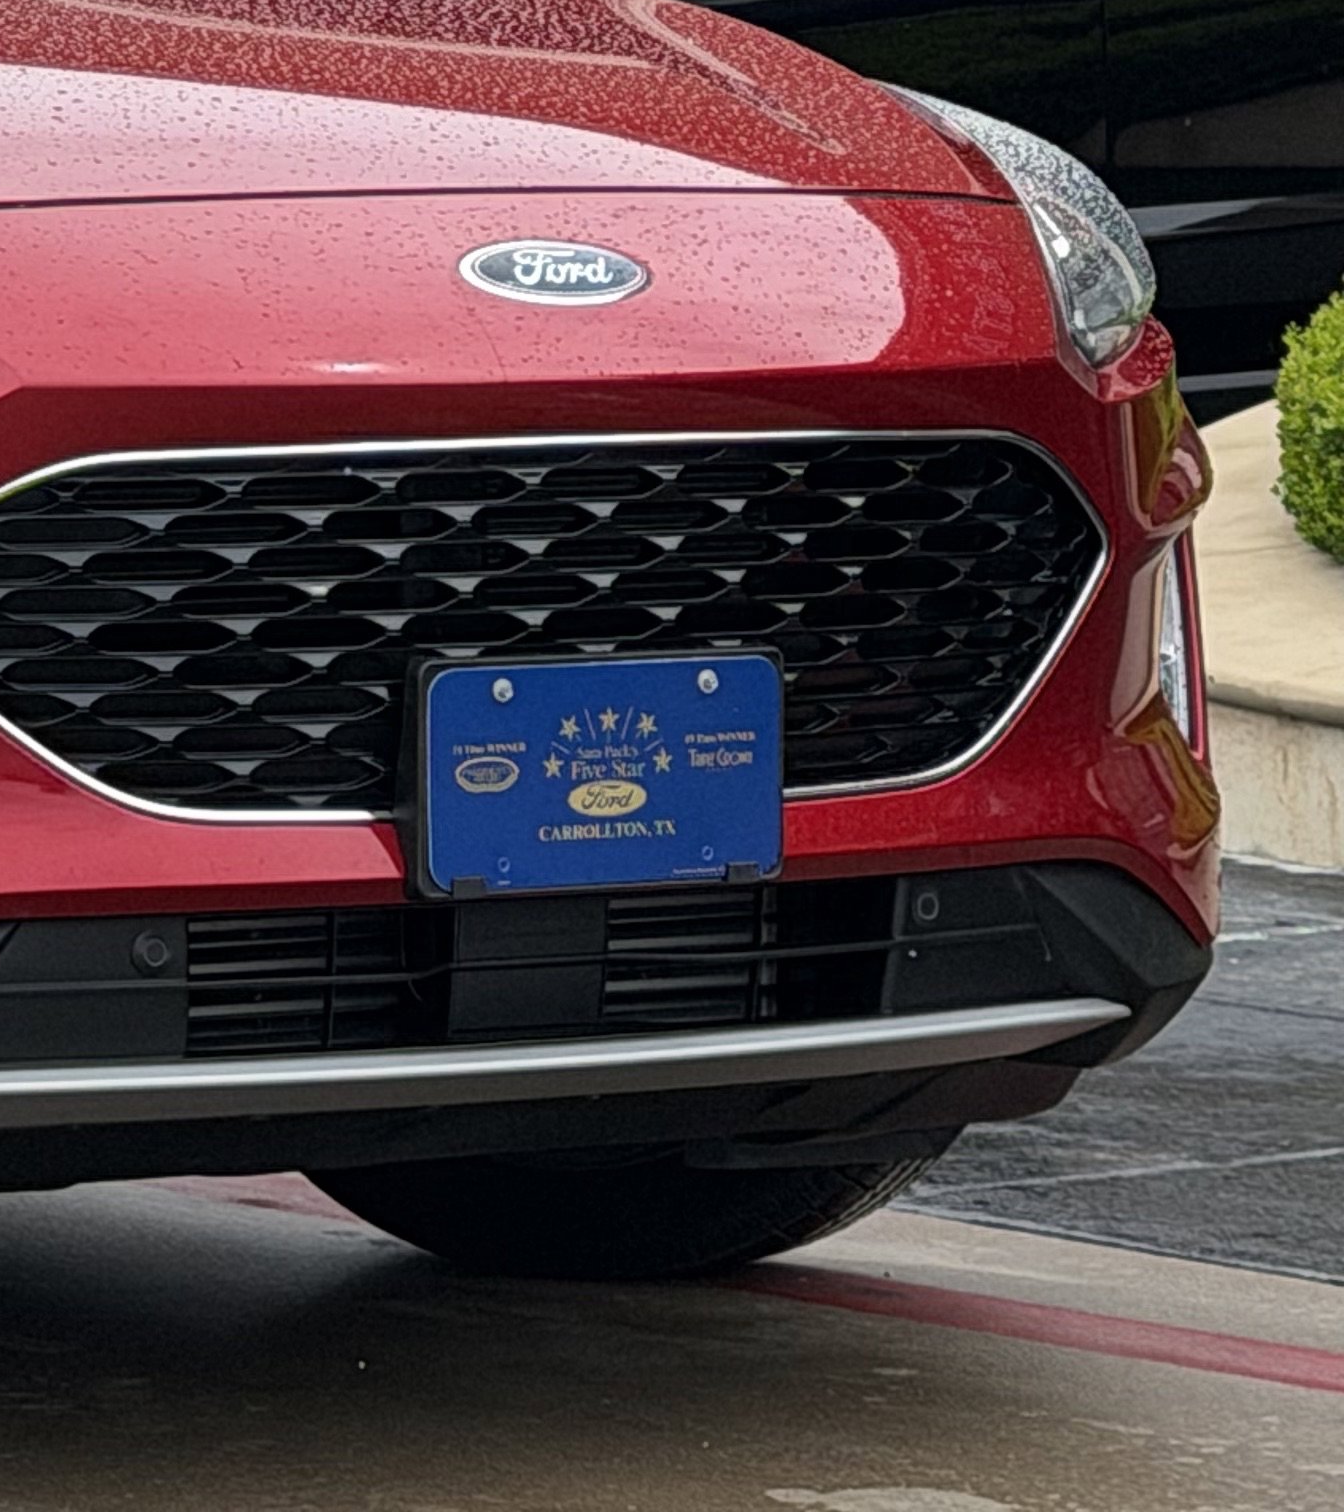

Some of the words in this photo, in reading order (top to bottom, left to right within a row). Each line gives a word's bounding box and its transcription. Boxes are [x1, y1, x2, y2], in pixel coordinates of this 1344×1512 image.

[512, 249, 613, 286] Ford
[571, 760, 607, 780] Five
[611, 759, 646, 777] Star
[581, 784, 634, 809] Ford
[538, 822, 652, 841] CARROLLTON,
[653, 820, 676, 835] TX
